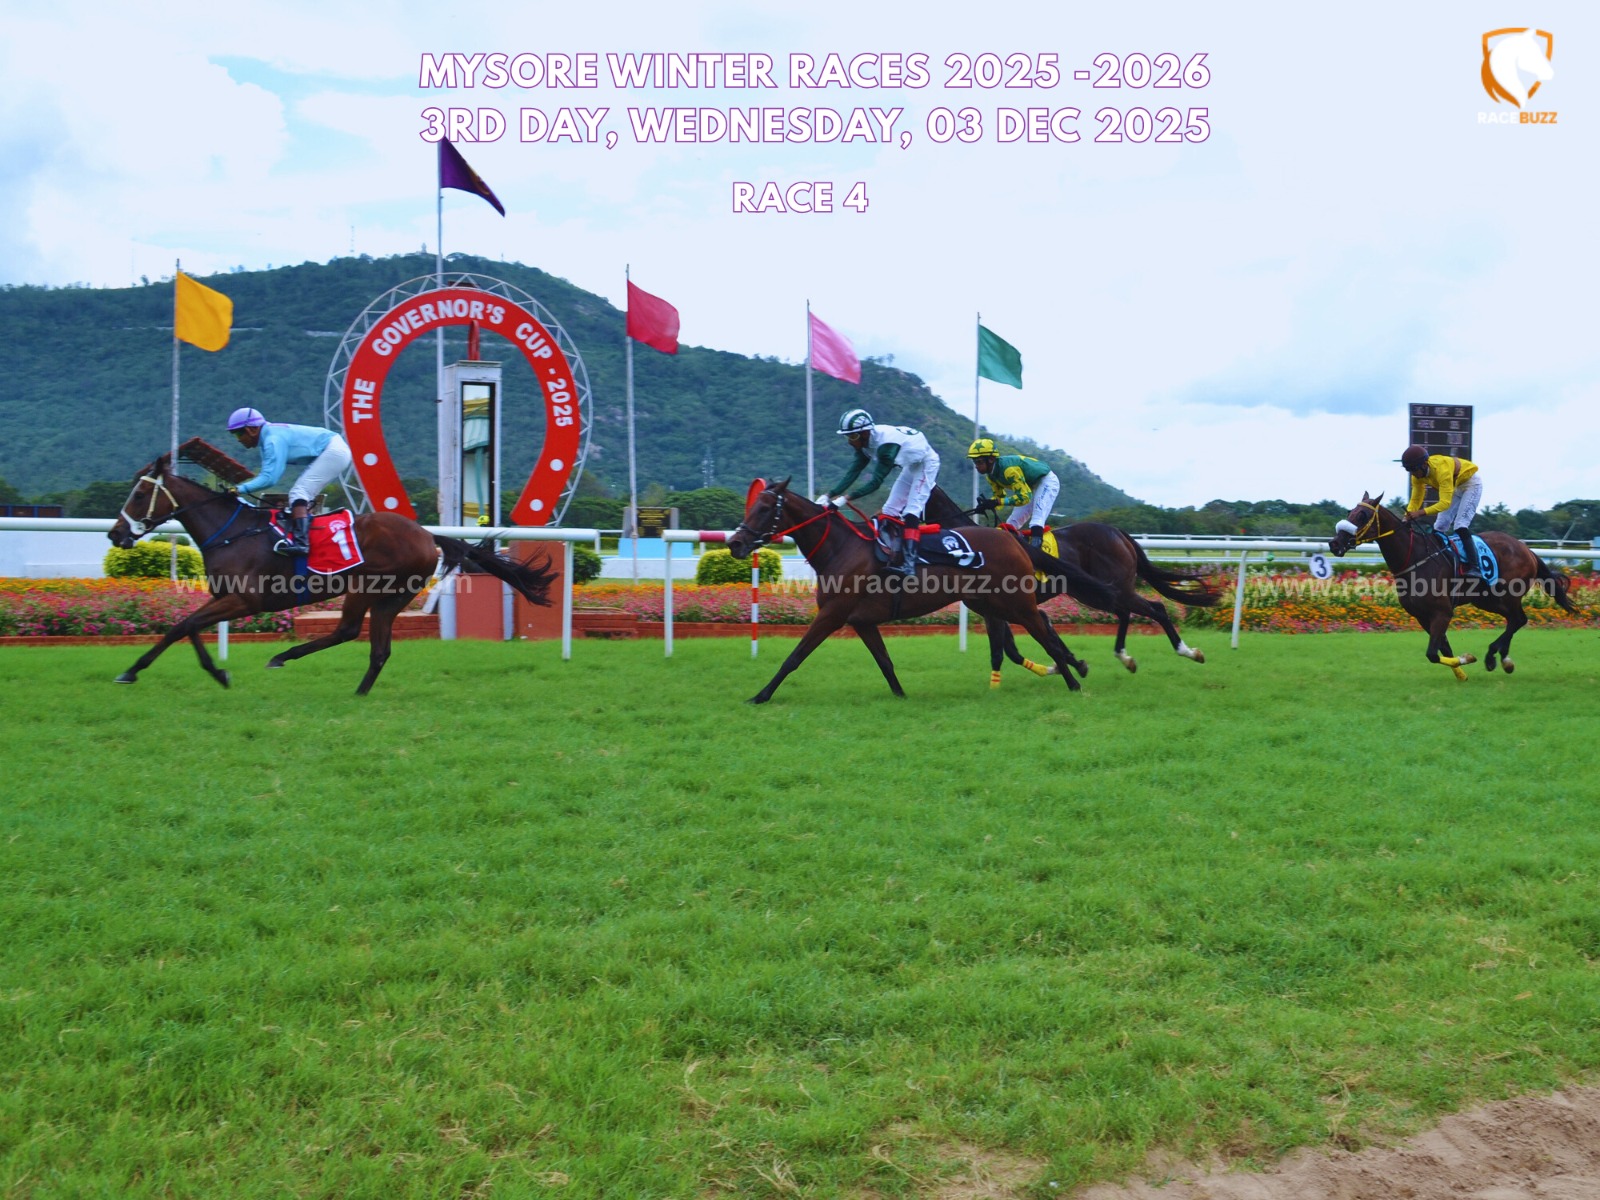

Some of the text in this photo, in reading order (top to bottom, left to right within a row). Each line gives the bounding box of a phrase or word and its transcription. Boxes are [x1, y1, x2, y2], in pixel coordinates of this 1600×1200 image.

[352, 378, 376, 424] THE
[371, 298, 507, 357] GOVERNOR'S
[515, 322, 552, 360] CUP
[546, 378, 573, 427] 2025
[331, 529, 353, 561] 1
[1314, 556, 1327, 577] 3
[1481, 555, 1495, 579] 9
